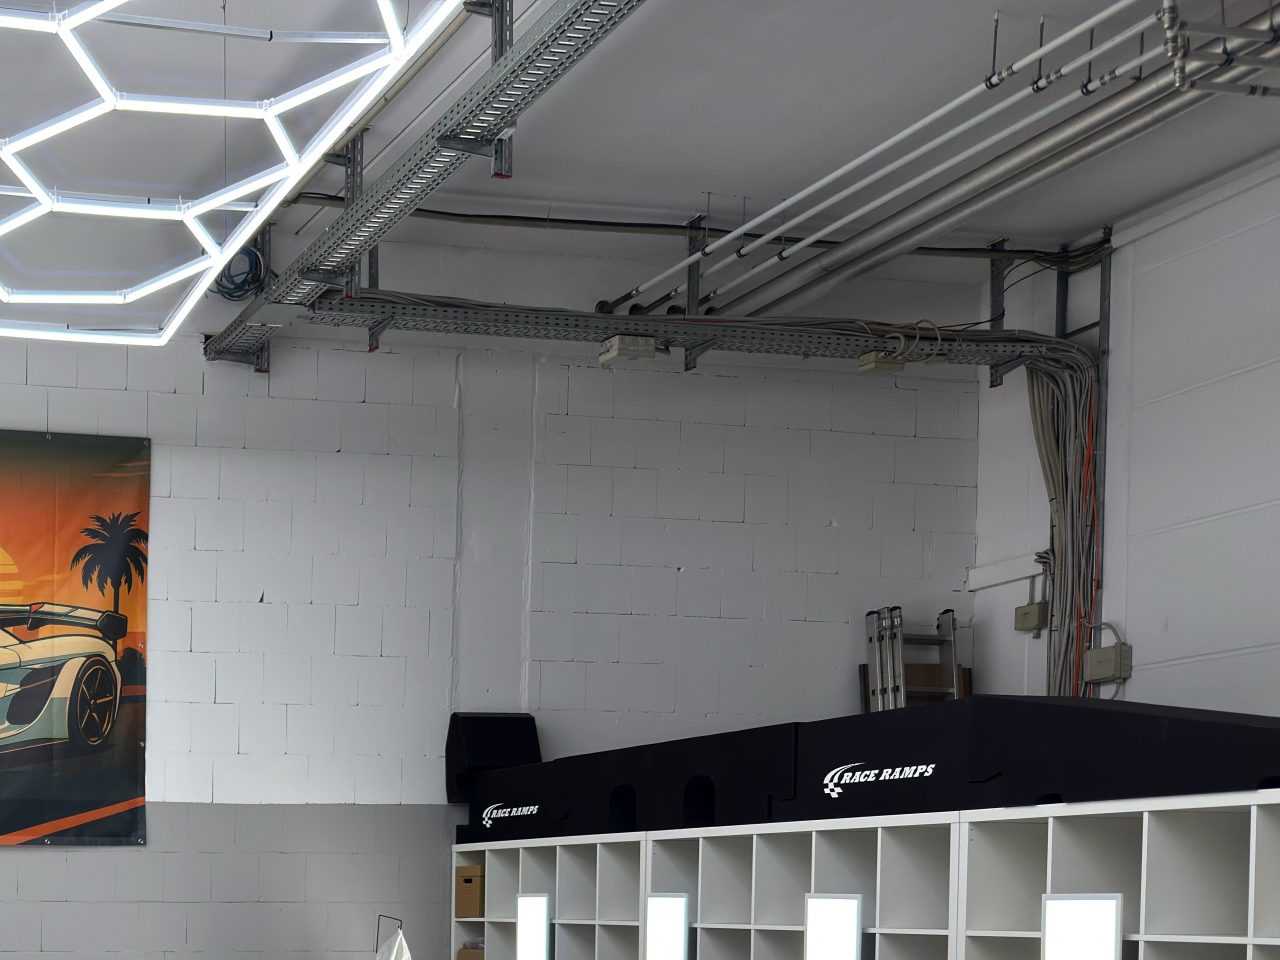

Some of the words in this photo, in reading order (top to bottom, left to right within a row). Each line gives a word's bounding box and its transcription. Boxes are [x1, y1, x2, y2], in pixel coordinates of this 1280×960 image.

[840, 769, 880, 784] RACE
[878, 763, 936, 780] RAMPS
[491, 808, 511, 818] RACE
[510, 805, 539, 817] RAMPS
